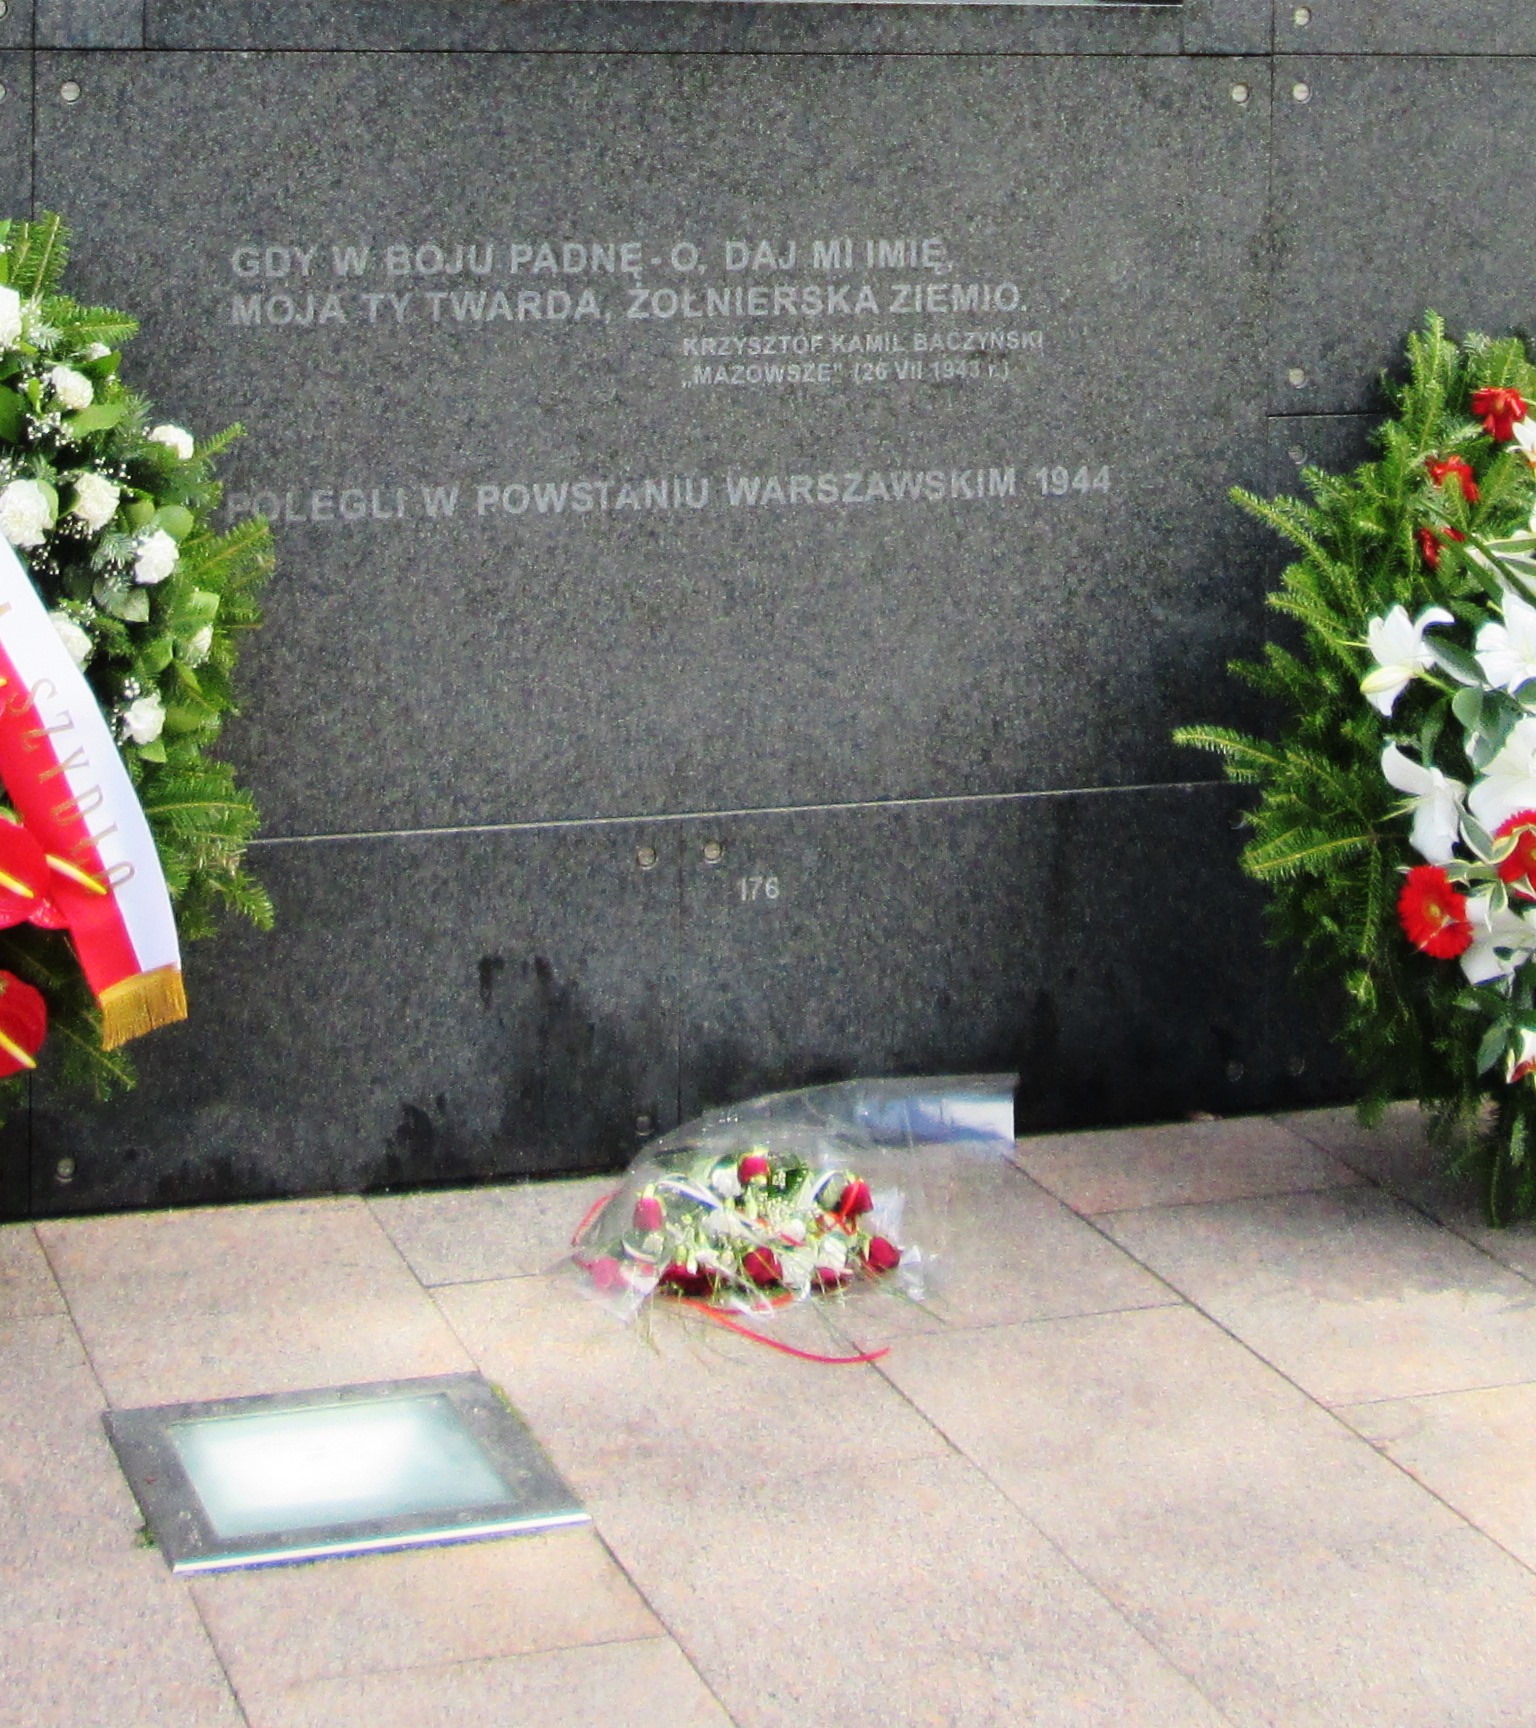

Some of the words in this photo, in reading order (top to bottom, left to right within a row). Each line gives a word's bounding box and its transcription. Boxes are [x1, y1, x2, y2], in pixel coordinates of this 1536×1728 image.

[231, 246, 315, 276] GDY
[332, 245, 366, 276] W
[387, 243, 493, 275] BOJU
[511, 242, 643, 279] PADNĘ
[671, 241, 706, 274] O,
[726, 241, 796, 271] DAJ
[814, 238, 852, 270] MI
[231, 292, 346, 324] MOJA
[364, 292, 413, 323] TY
[424, 289, 612, 323] TWARDA,
[626, 282, 879, 319] ŻOŁNIERSKA
[889, 281, 1027, 315] ZIEMIO.
[683, 334, 823, 356] KRZYSZTOF
[832, 334, 905, 354] KAMIL
[914, 329, 1044, 352] BACZYŃSKI
[853, 362, 888, 385] (26
[895, 361, 924, 380] VII
[226, 487, 405, 525] POLEGLI
[423, 485, 462, 517] W
[477, 478, 710, 516] POWSTANIU
[726, 469, 1016, 506] WARSZAWSKIM
[1037, 466, 1111, 496] 1944
[737, 876, 780, 902] 176
